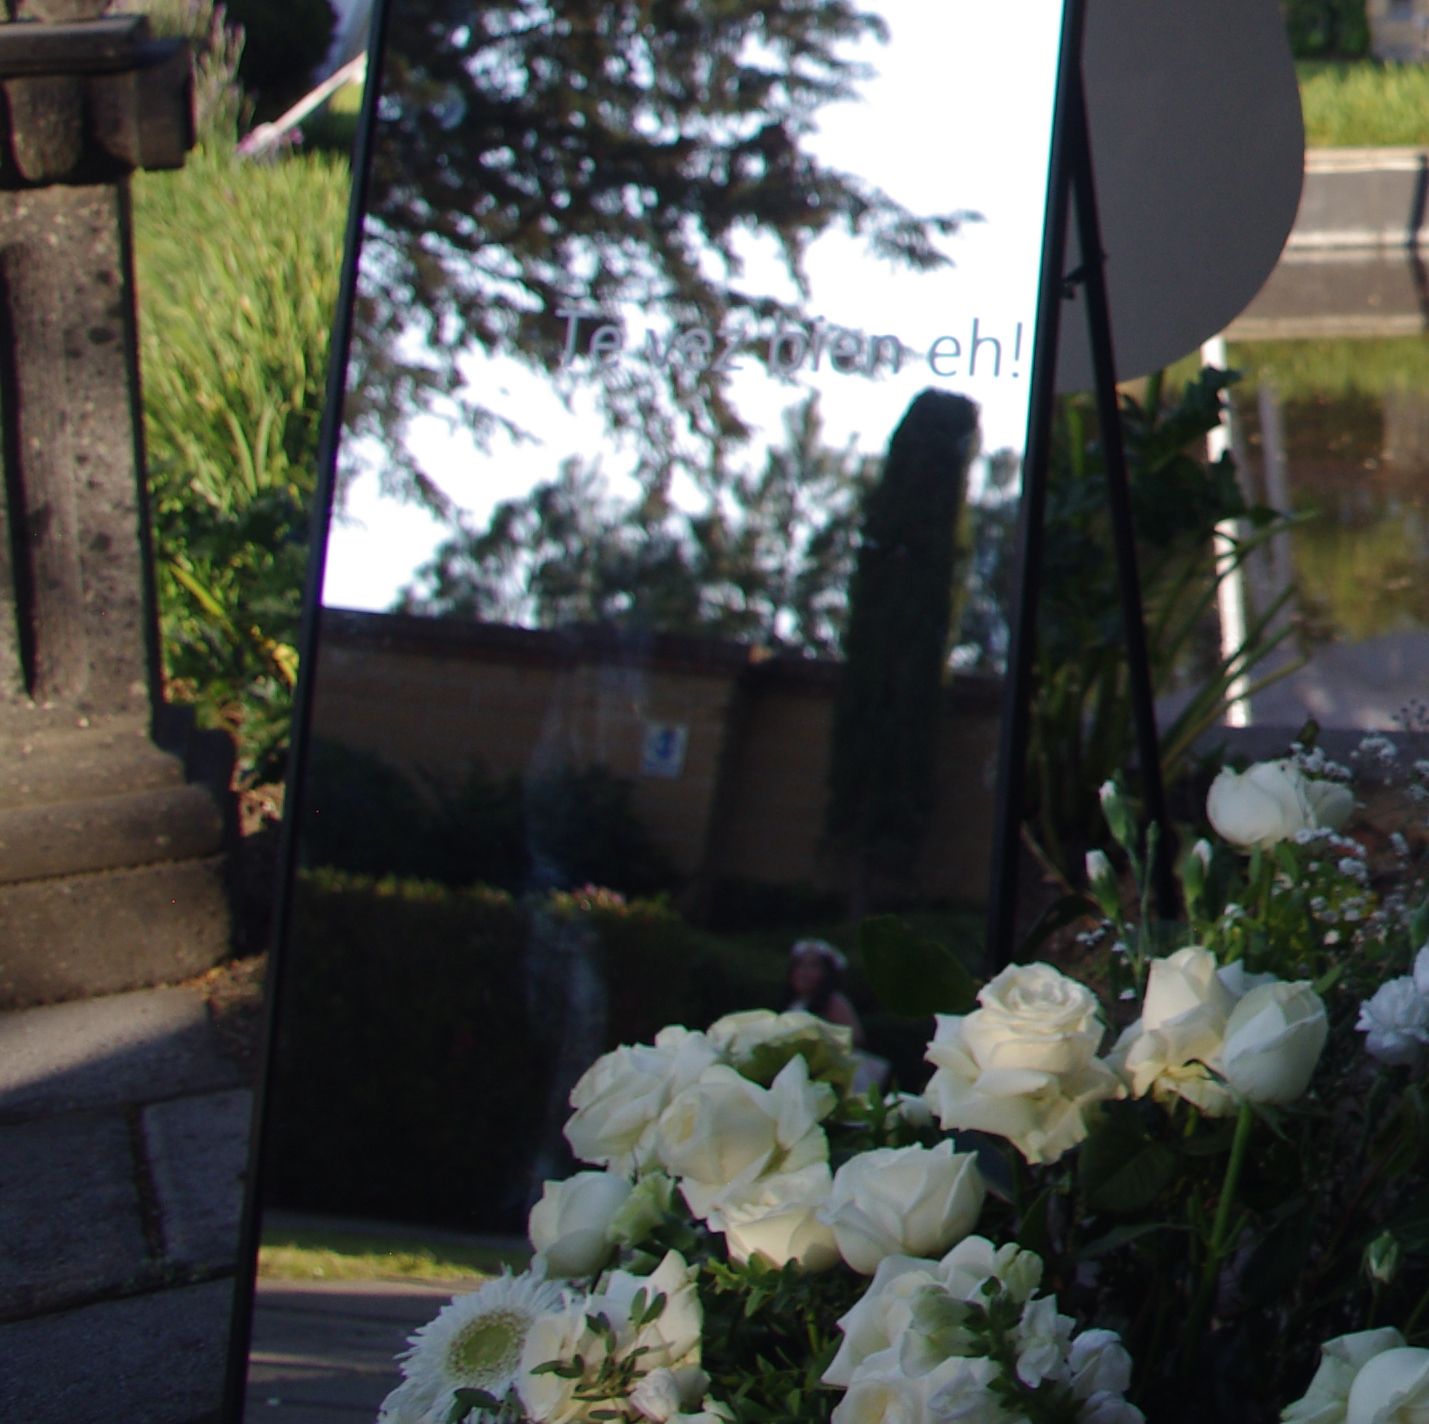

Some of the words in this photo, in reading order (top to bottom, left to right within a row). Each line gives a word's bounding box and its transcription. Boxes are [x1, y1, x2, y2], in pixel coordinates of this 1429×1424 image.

[555, 308, 624, 368] Te
[646, 327, 746, 373] vez
[768, 309, 902, 376] bien
[927, 317, 1023, 378] eh!
